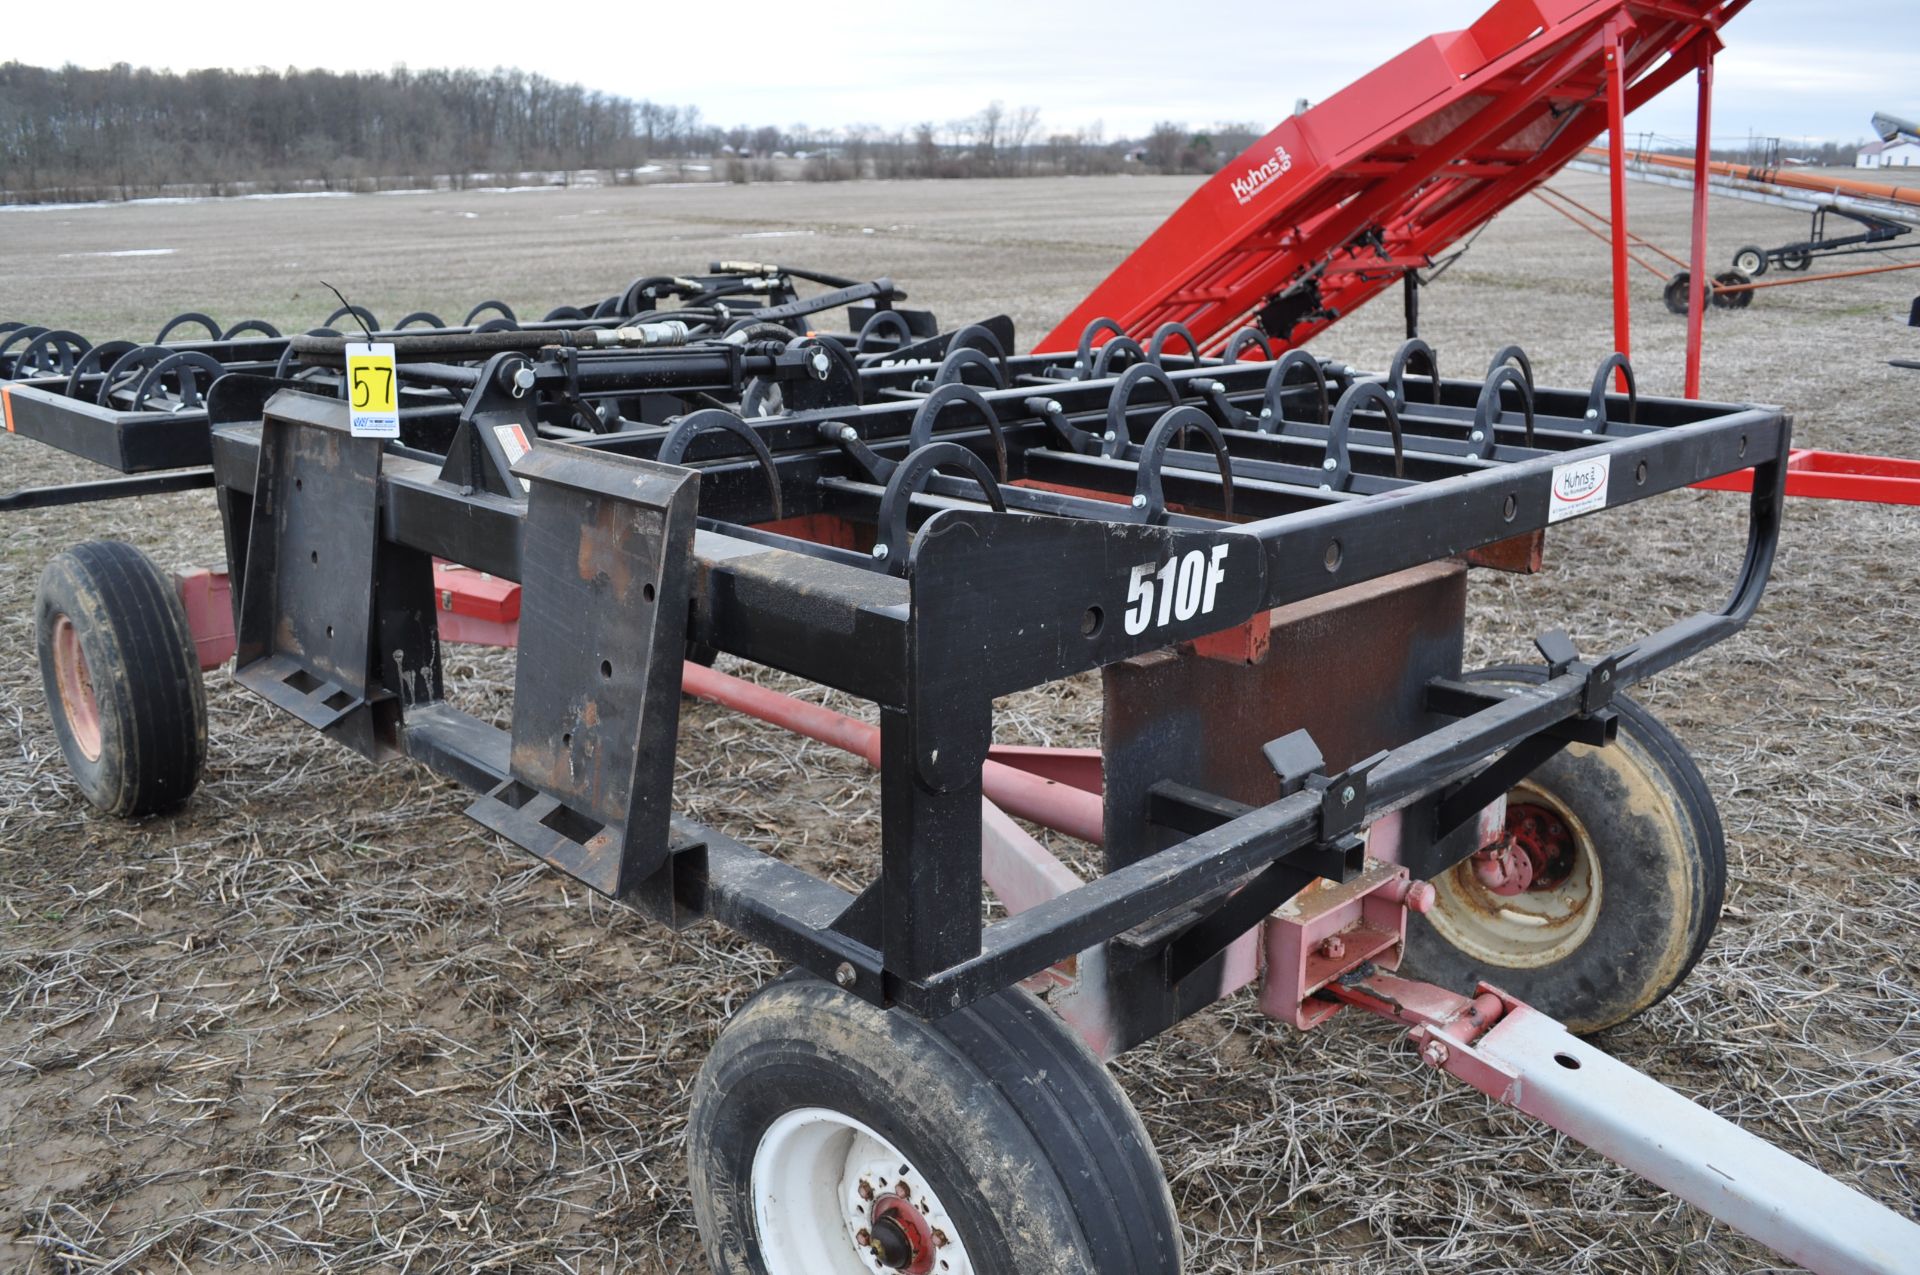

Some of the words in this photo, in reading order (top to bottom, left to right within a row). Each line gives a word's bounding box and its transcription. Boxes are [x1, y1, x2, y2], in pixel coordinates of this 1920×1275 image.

[1231, 157, 1280, 198] Kuhns
[353, 366, 393, 408] 57
[1563, 470, 1590, 490] Kuhns
[1124, 543, 1229, 636] 510F
